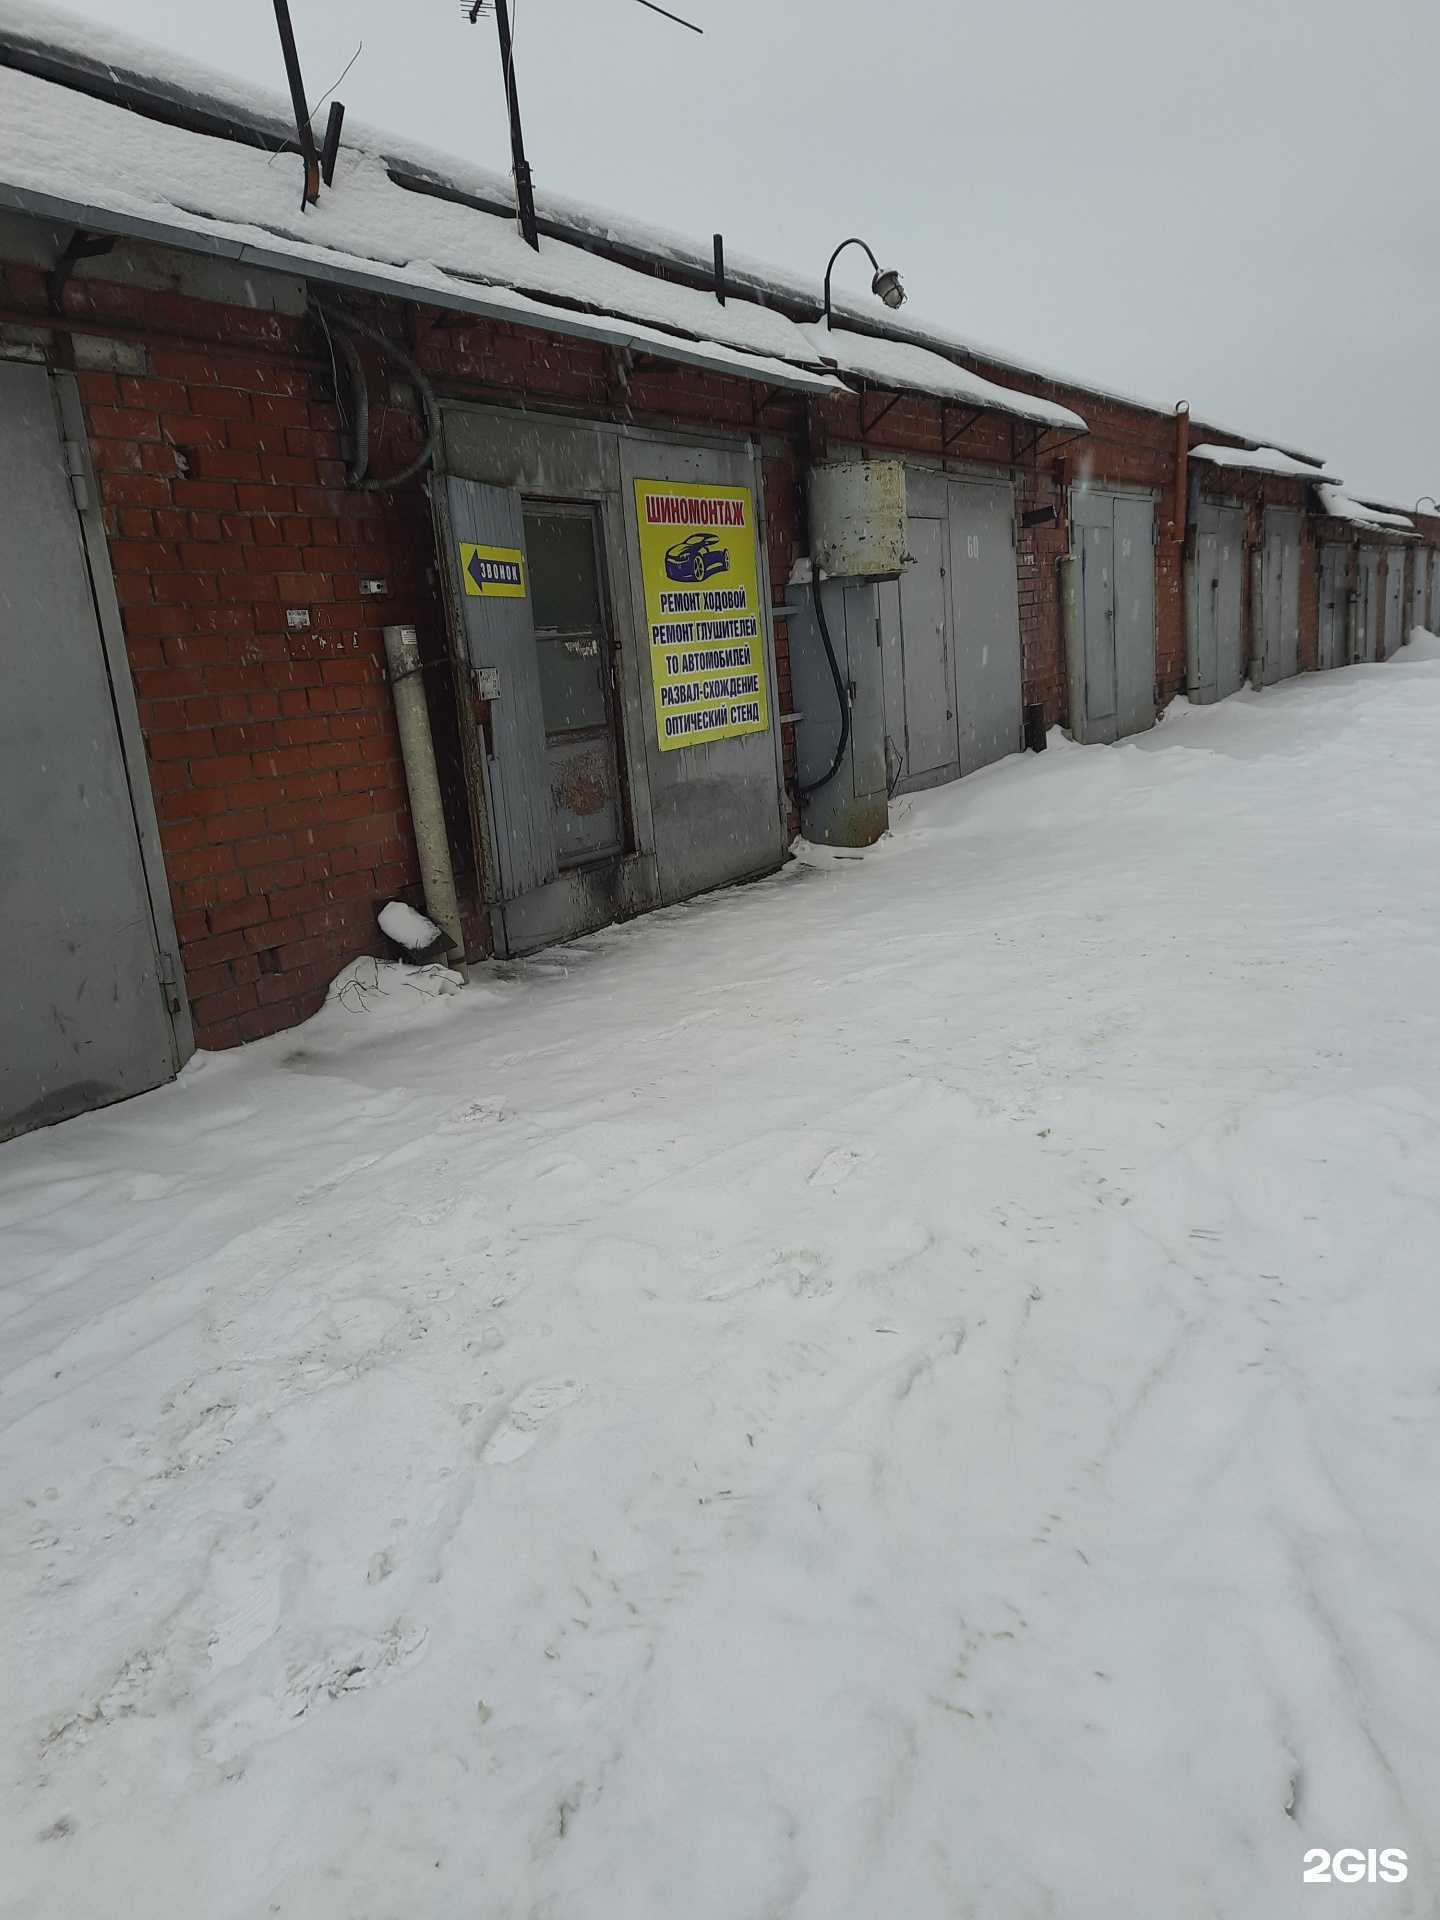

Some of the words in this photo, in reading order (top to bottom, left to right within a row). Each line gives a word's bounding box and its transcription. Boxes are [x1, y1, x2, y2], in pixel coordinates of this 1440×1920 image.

[645, 495, 745, 527] ШИНОМОНТАЖ
[480, 562, 519, 581] ЗВОНОК
[660, 592, 701, 613] РЕМОНТ
[703, 586, 747, 612] ХОДОВОЙ
[652, 623, 694, 645] РЕМОНТ
[695, 615, 757, 641] ГЛУШИТЕЛЕЙ
[665, 655, 679, 675] ТО
[681, 643, 752, 673] АВТОМОБИЛЕЙ
[660, 674, 760, 707] РАЗВАЛ-СХОЖДЕНИЕ
[665, 704, 729, 736] ОПТИЧЕСКИЙ
[730, 702, 760, 724] СТЕНД
